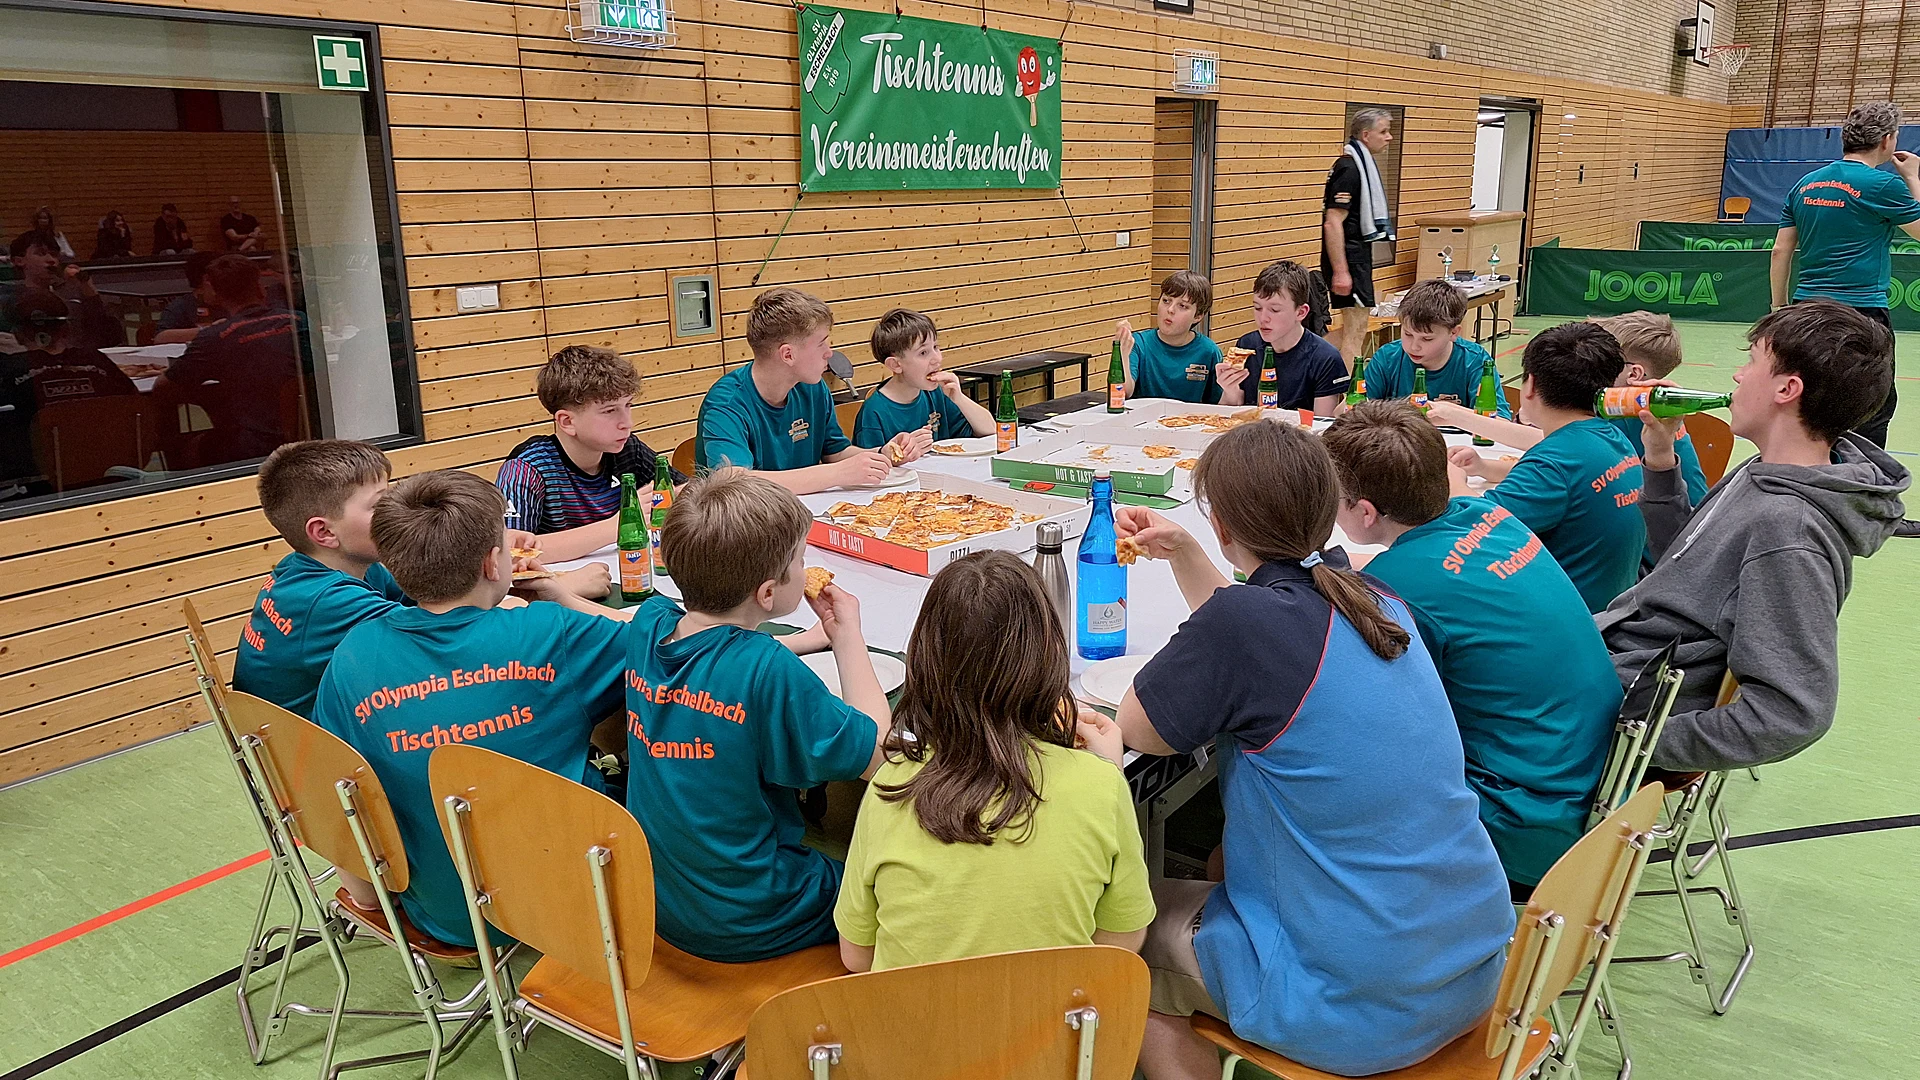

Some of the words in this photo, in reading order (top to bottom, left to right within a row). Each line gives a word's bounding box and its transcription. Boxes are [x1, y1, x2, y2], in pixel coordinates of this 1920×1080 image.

[811, 19, 822, 35] SV
[806, 24, 829, 63] OLYMPIA
[810, 23, 838, 80] ESCHELBACH
[828, 69, 840, 88] 1919
[860, 33, 1005, 97] Tischtennis
[811, 121, 1053, 184] Vereinsmeisterschaften
[1803, 196, 1846, 208] Tischtennis
[1055, 467, 1068, 482] HOT
[1069, 468, 1076, 482] &
[1591, 474, 1607, 493] SV
[829, 529, 840, 546] HOT
[848, 535, 864, 554] TASTY
[1442, 550, 1465, 575] SV
[354, 698, 371, 724] SV
[371, 674, 449, 711] Olympia
[451, 660, 556, 689] Eschelbach
[654, 684, 747, 725] Eschelbach
[386, 705, 534, 752] Tischtennis
